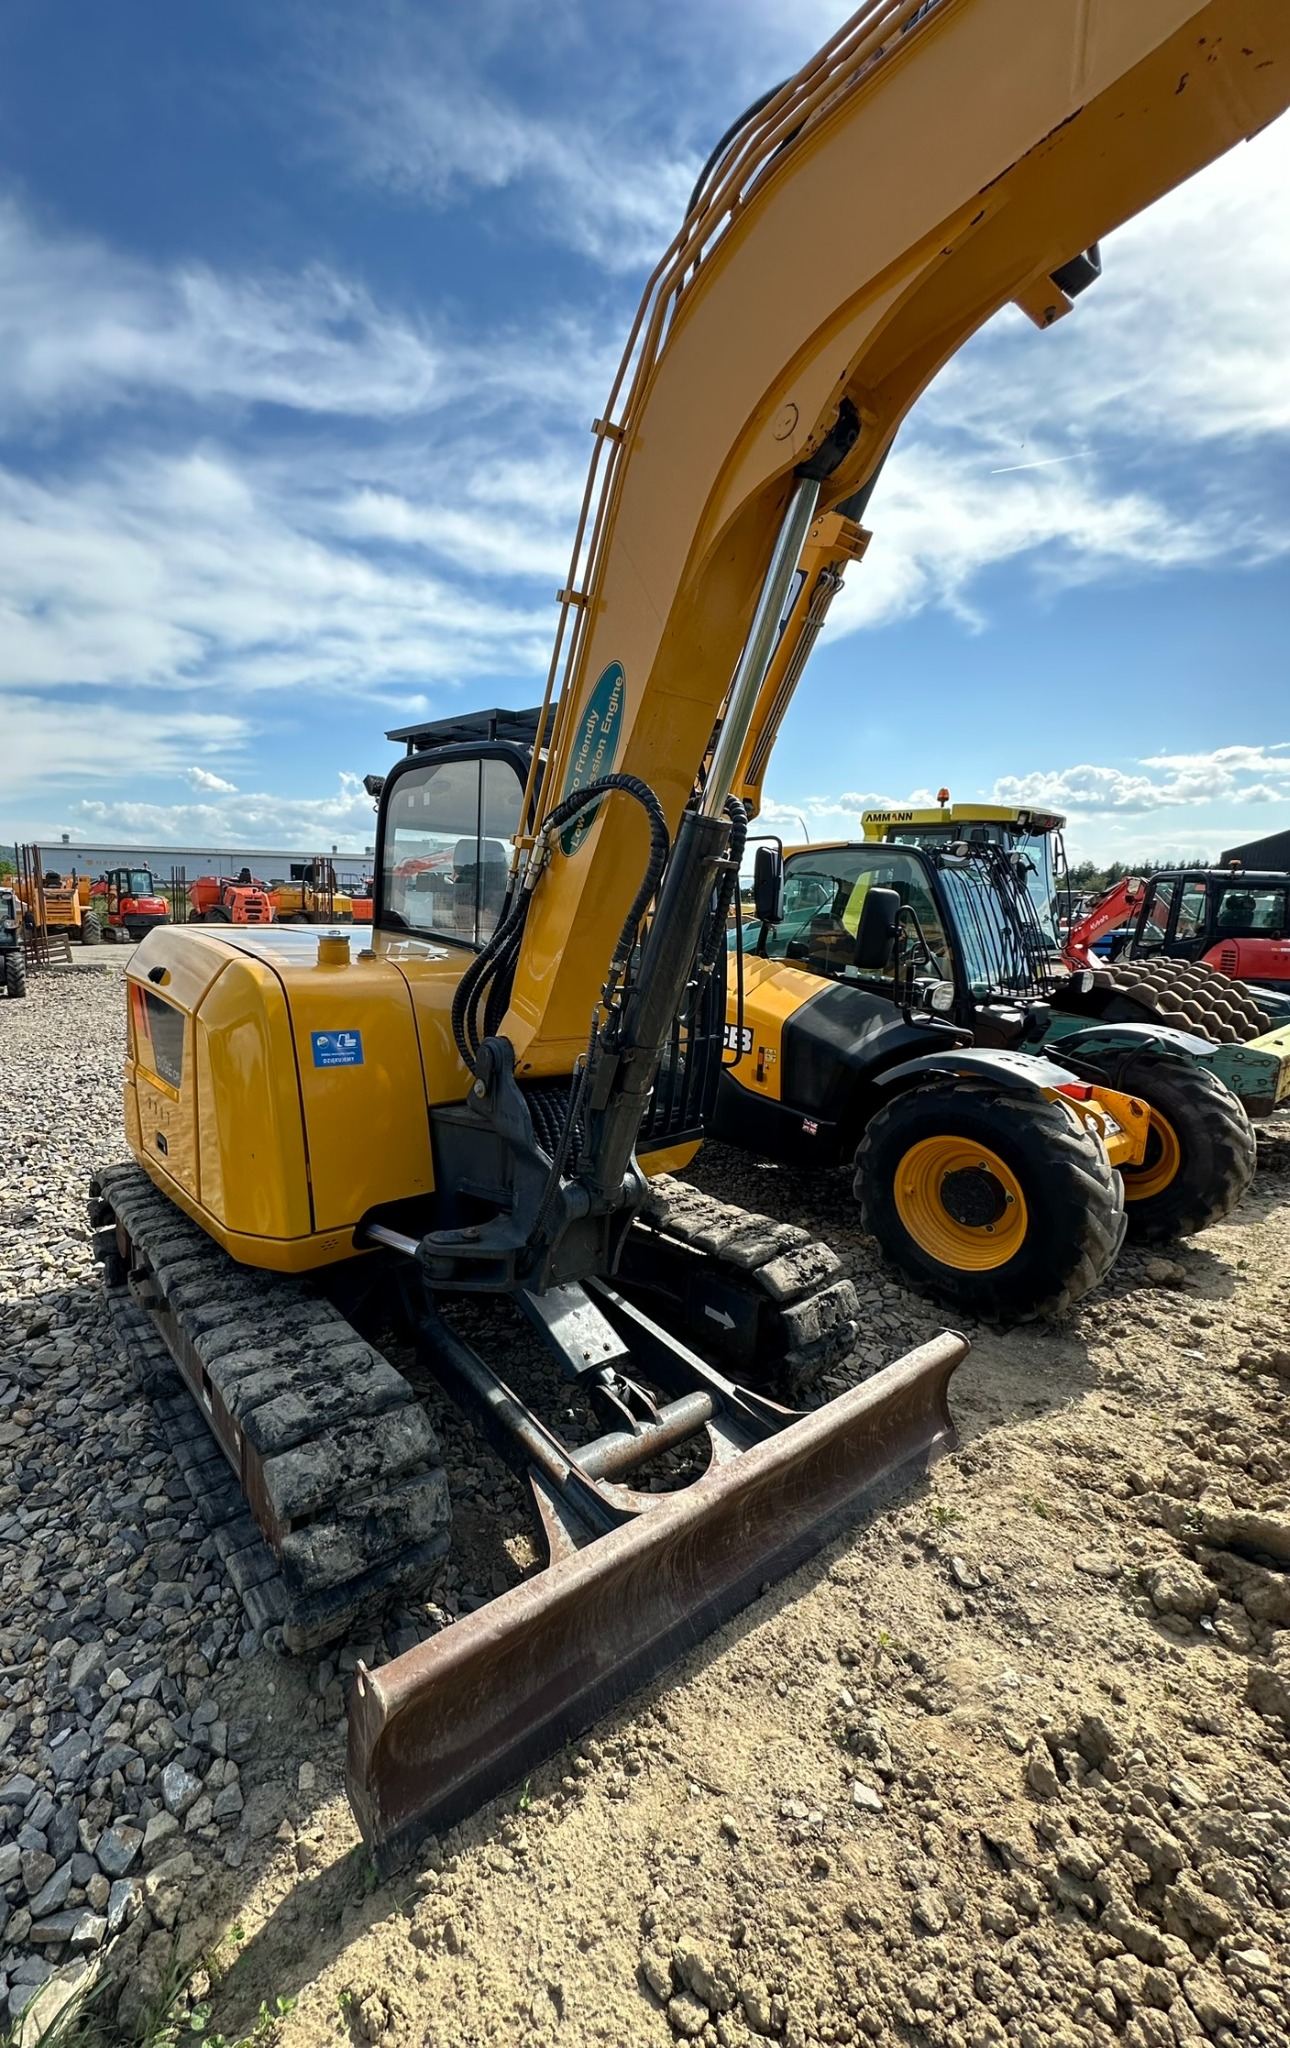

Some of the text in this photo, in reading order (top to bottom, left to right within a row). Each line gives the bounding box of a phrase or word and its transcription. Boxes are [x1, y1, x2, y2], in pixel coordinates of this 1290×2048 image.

[570, 815, 585, 847] Low
[601, 676, 623, 735] Engine
[575, 708, 600, 773] Friendly
[866, 812, 913, 822] AMMANN
